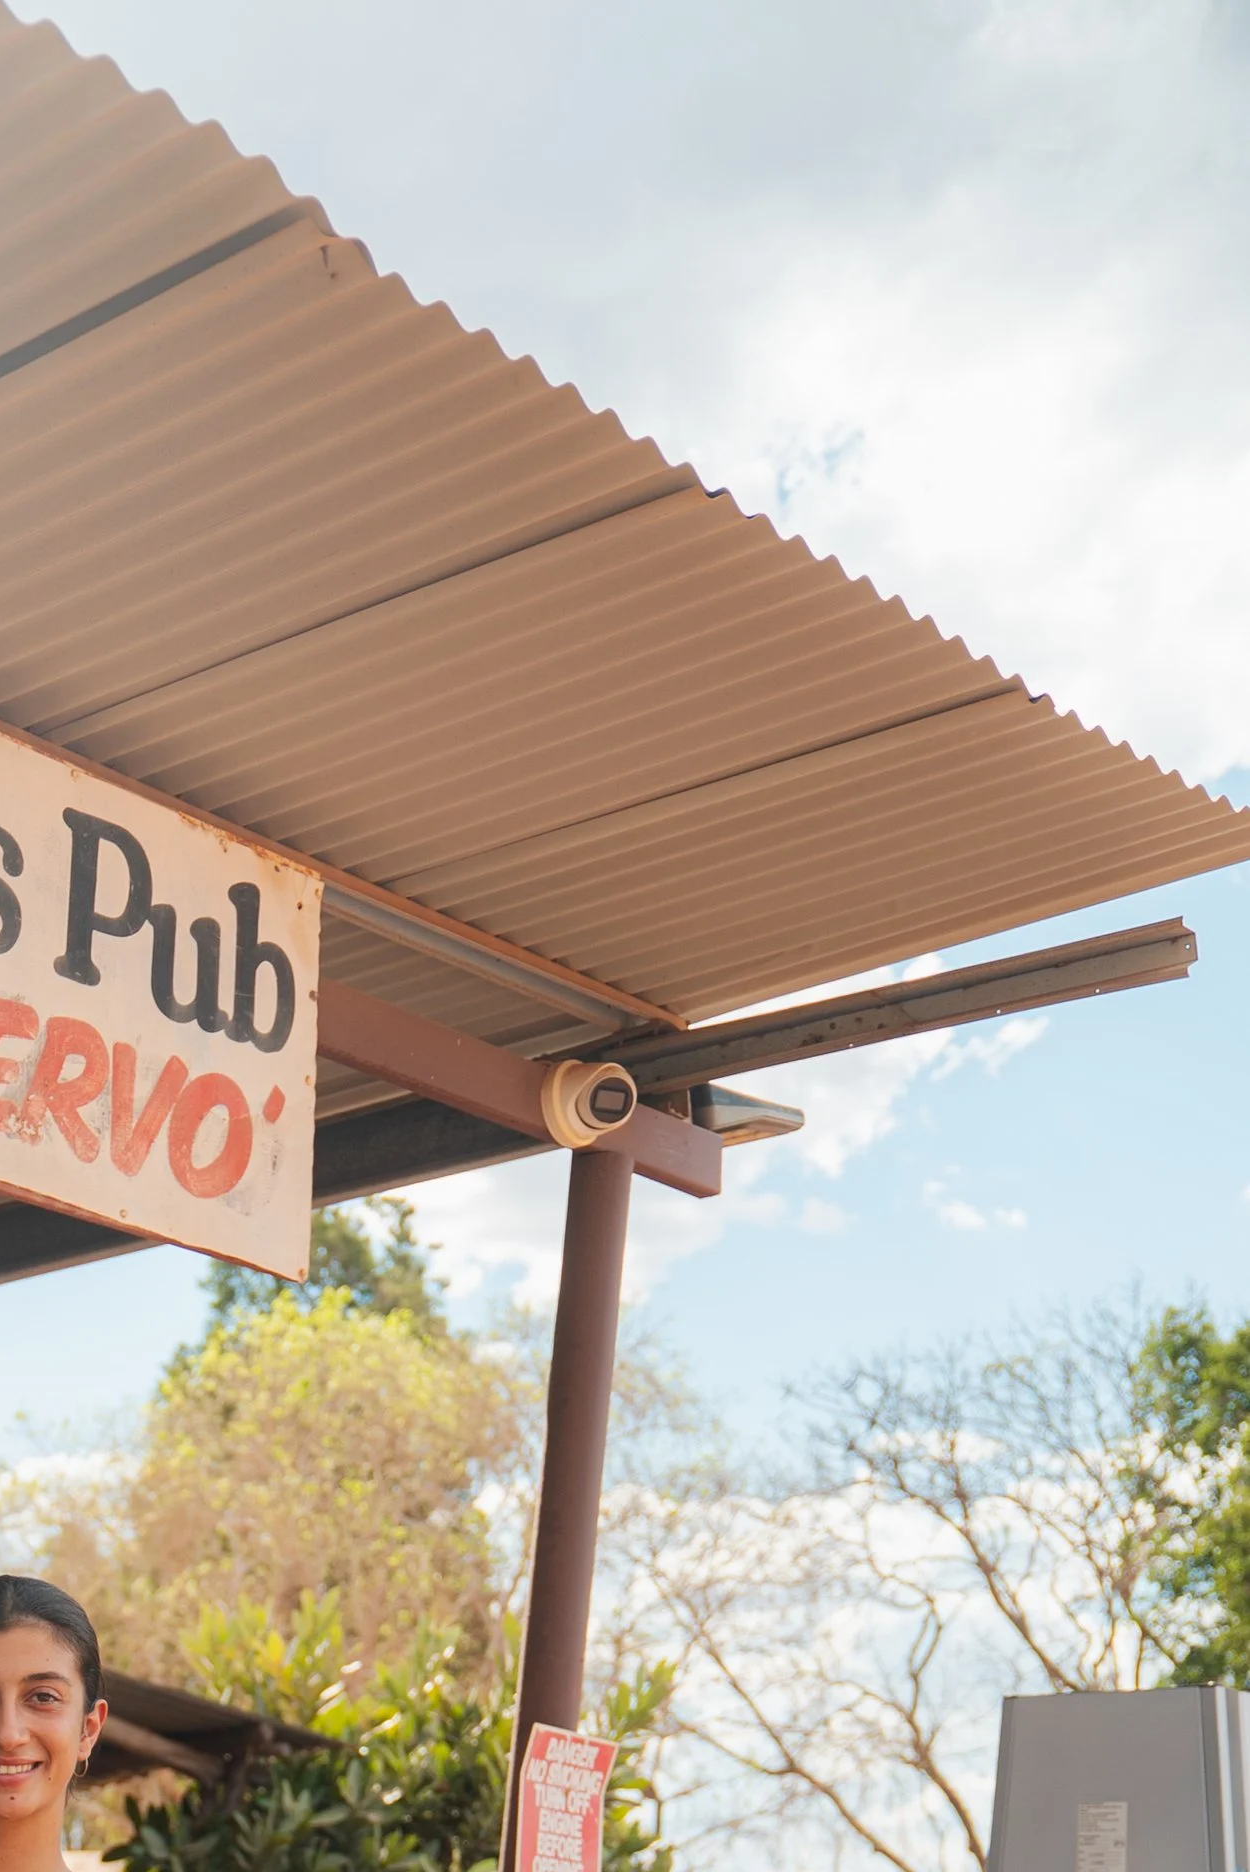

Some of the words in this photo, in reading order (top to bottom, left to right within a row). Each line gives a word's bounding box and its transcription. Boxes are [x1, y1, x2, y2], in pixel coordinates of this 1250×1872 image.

[53, 807, 295, 1053] Pub
[545, 1737, 599, 1768] DANGER
[526, 1758, 547, 1782] NO
[547, 1764, 603, 1795] SMOKING
[535, 1784, 566, 1809] TURN
[567, 1790, 591, 1815] OFF
[539, 1808, 583, 1837] ENGINE
[537, 1833, 583, 1861] BEFORE
